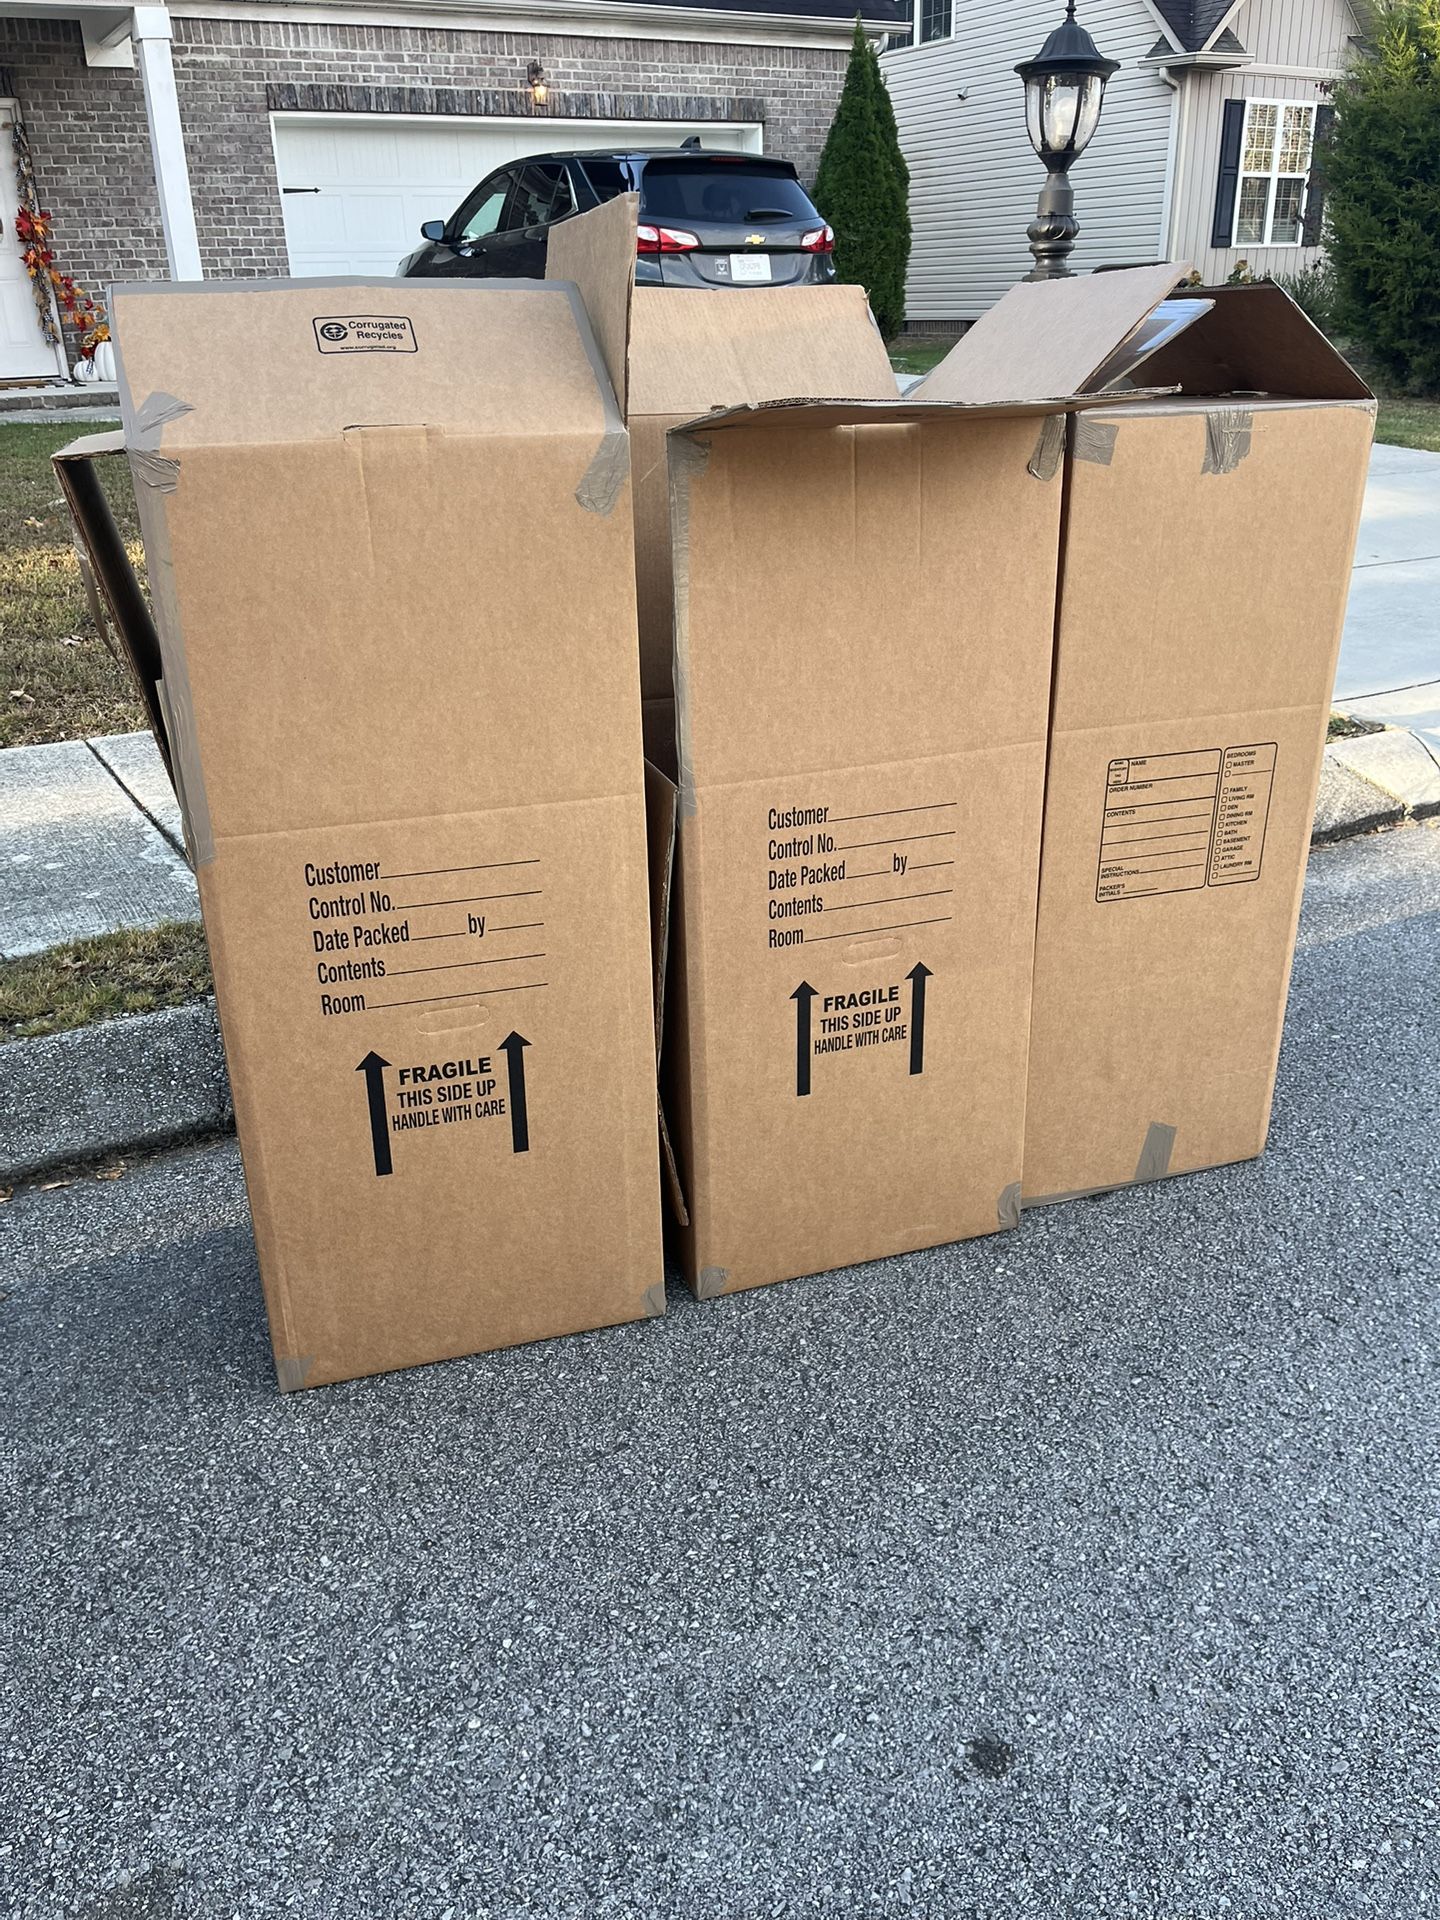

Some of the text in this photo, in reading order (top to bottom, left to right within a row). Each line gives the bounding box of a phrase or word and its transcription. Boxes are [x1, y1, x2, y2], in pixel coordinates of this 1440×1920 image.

[349, 321, 406, 330] Corrugated
[357, 331, 403, 340] Recycles
[1109, 783, 1152, 793] ORDER NUMBER
[769, 807, 829, 830] Customer
[769, 833, 836, 860] Control No.
[1223, 836, 1250, 844] BASEMENT
[305, 862, 380, 886] Customer
[769, 853, 907, 890] Date Packed by
[1101, 870, 1139, 879] INSTRUCTIONS
[309, 891, 395, 919] Control No.
[769, 895, 823, 919] Contents
[313, 913, 485, 952] Date Packed by
[769, 928, 803, 948] Room
[318, 957, 386, 984] Contents
[322, 994, 365, 1015] Room
[824, 986, 898, 1012] FRAGILE
[821, 1007, 901, 1033] THIS SIDE UP
[815, 1025, 906, 1055] HANDLE WITH CARE
[399, 1057, 491, 1085] FRAGILE
[397, 1079, 496, 1108] THIS SIDE UP
[392, 1099, 505, 1131] HANDLE WITH CARE
